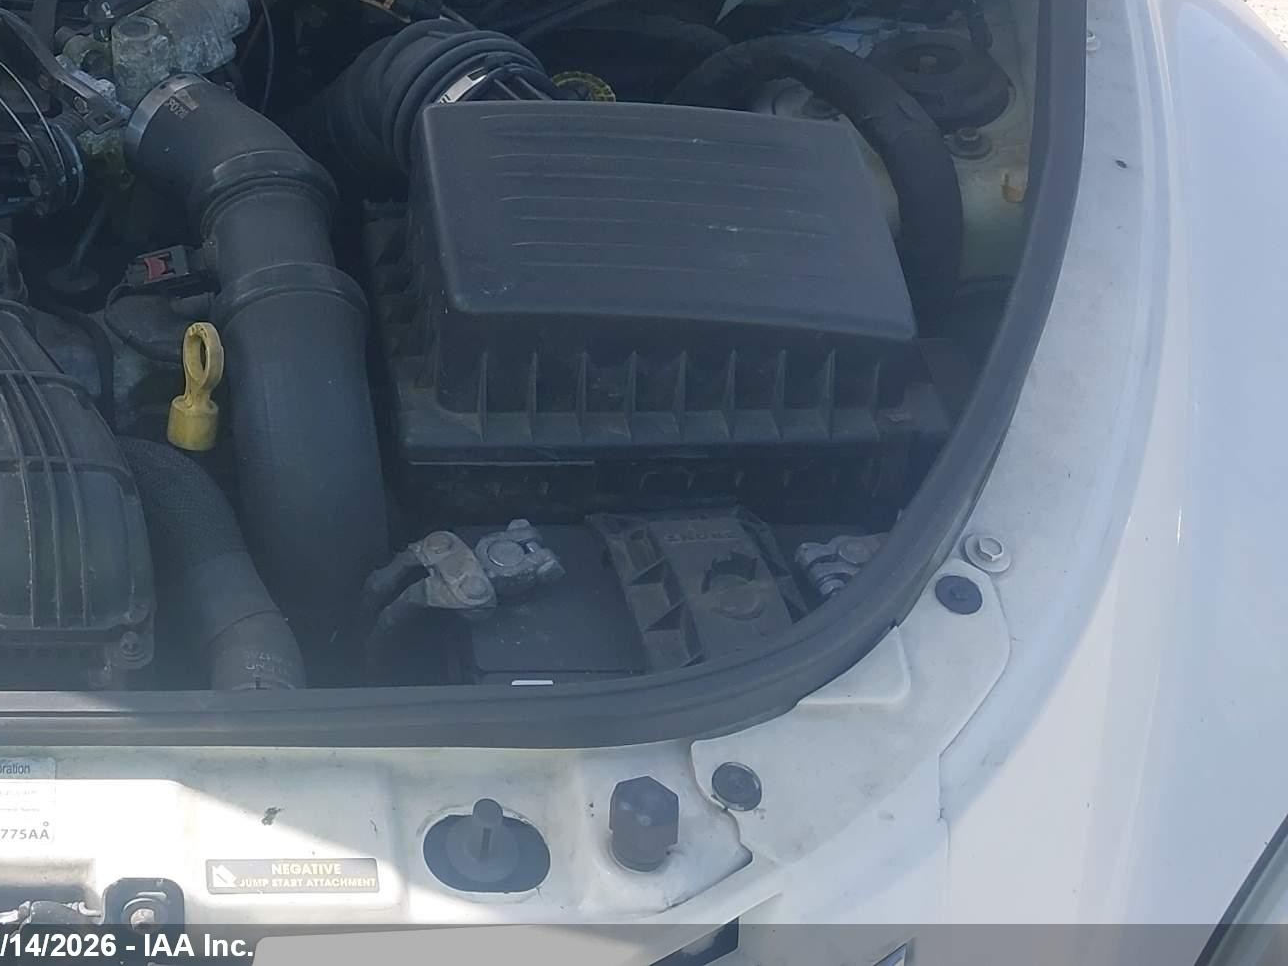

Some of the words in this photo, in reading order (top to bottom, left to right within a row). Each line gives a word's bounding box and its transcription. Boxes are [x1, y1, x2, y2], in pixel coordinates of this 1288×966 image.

[271, 863, 342, 875] NEGATIVE
[239, 877, 269, 887] JUMP
[272, 878, 303, 887] START
[307, 878, 376, 887] ATTACHMENT
